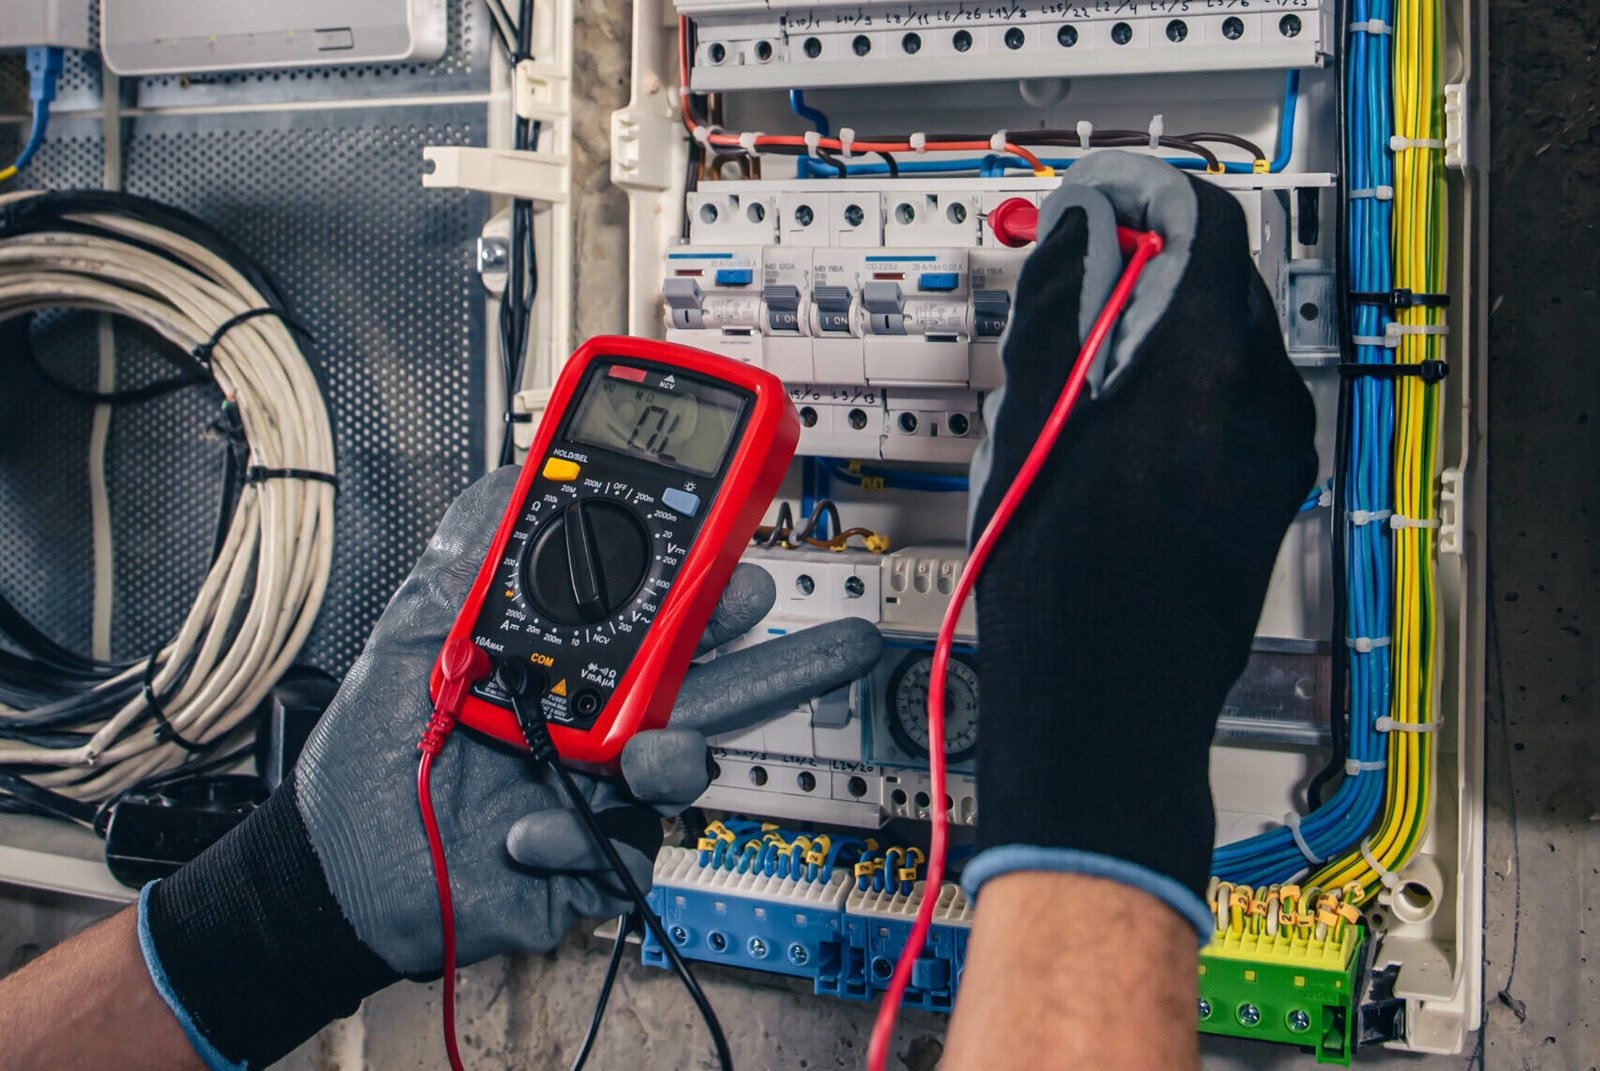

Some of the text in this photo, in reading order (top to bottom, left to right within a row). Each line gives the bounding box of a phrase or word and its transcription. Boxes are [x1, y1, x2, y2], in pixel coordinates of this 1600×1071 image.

[834, 317, 848, 325] ON
[659, 381, 676, 390] NCV
[553, 448, 589, 463] HOLD/SEL
[583, 478, 602, 488] 200M
[613, 482, 628, 491] OFF
[560, 484, 577, 494] 20M
[635, 492, 654, 503] 200m
[653, 510, 677, 522] 2000m
[662, 530, 673, 539] 20
[503, 557, 516, 567] 200
[662, 556, 677, 565] 200
[655, 579, 670, 589] 600
[642, 602, 656, 612] 600
[526, 624, 541, 635] 20m
[618, 622, 633, 633] 200
[543, 633, 562, 645] 200m
[571, 638, 580, 647] 10
[592, 633, 610, 645] NCV
[530, 652, 554, 668] COM
[1238, 897, 1248, 906] 2
[1257, 903, 1266, 912] 2
[1282, 914, 1292, 922] 2
